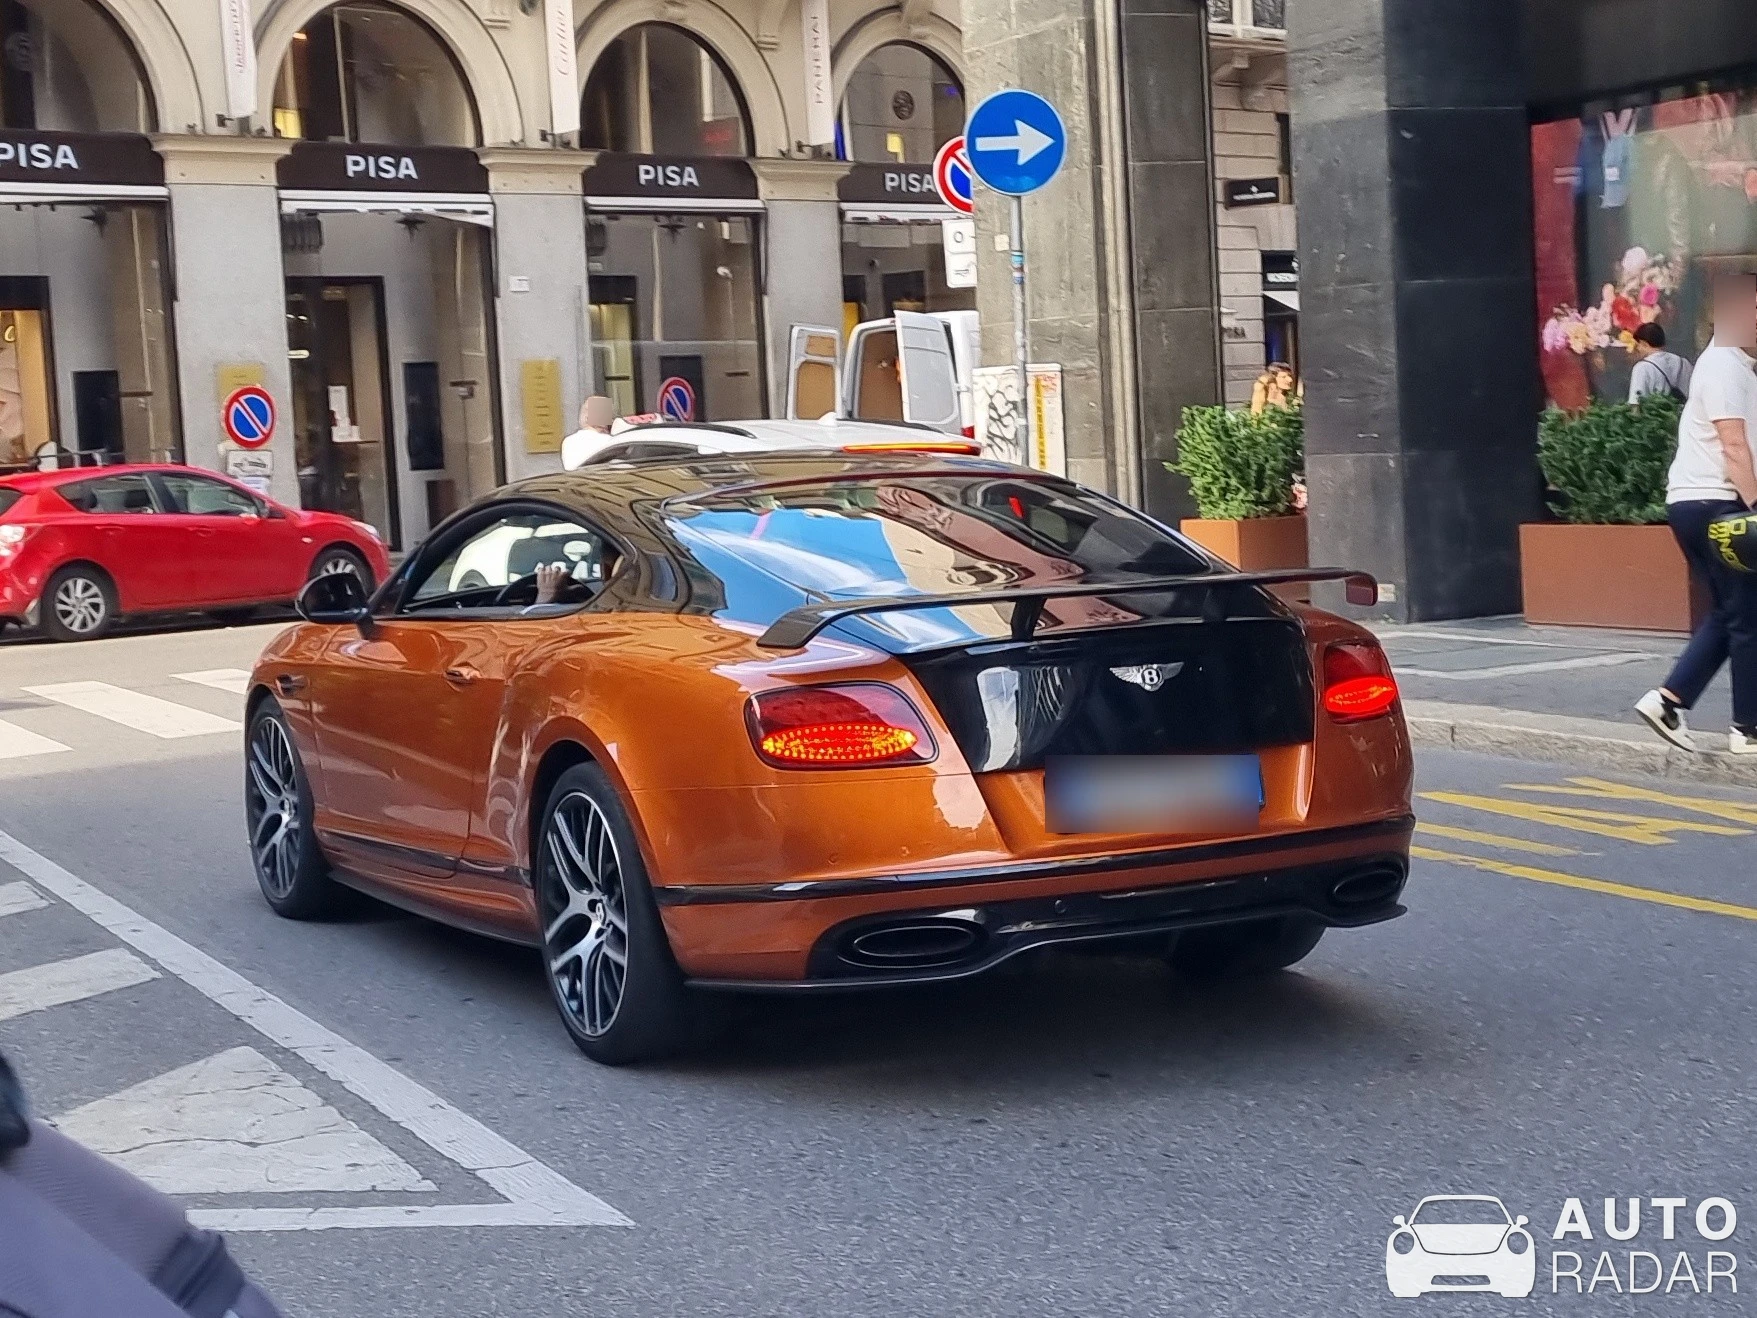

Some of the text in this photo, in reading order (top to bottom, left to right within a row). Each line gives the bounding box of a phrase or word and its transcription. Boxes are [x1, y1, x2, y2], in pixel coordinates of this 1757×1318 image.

[0, 142, 79, 169] PISA
[345, 155, 418, 180] PISA
[638, 164, 699, 187] PISA
[884, 172, 937, 193] PISA
[1144, 668, 1159, 685] B
